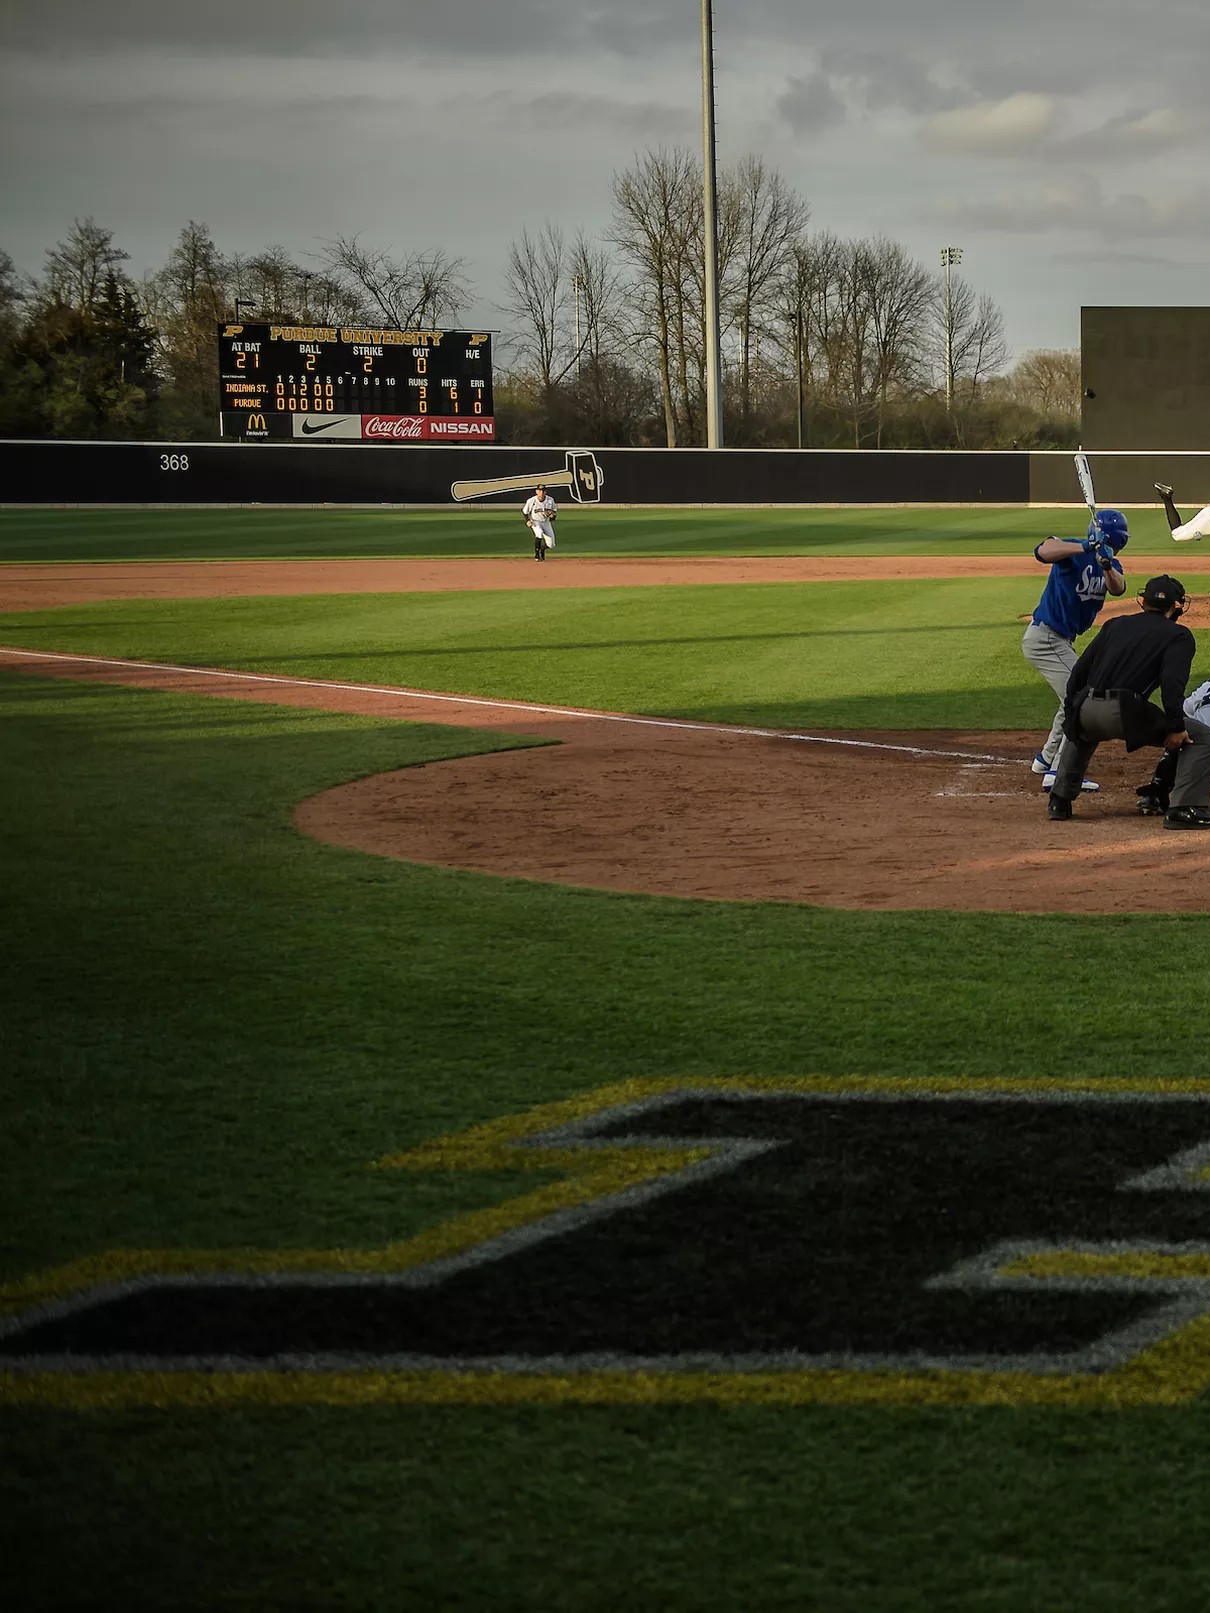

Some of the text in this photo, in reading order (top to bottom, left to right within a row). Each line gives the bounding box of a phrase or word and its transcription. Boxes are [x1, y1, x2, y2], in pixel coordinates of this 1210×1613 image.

[270, 326, 443, 346] PURDUE UNIVERSITY
[231, 342, 261, 352] AT BAT
[299, 344, 321, 354] BALL
[352, 346, 383, 357] STRIKE
[412, 347, 430, 358] OUT
[465, 349, 480, 359] H/E
[306, 354, 316, 371] 2
[363, 355, 373, 372] 2
[417, 357, 427, 374] 0
[277, 375, 396, 386] 1 2 3 4 5 6 7 8 9 10
[408, 378, 428, 387] RUNS
[441, 378, 458, 388] HITS
[470, 379, 485, 388] ERR
[225, 382, 482, 400] INDIANA ST. 0 1 2 0 0 3 6 1
[233, 397, 482, 414] PURDUE 0 0 0 0 0 0 1 0
[365, 416, 425, 438] Coca-Cola
[430, 422, 493, 434] NISSAN
[160, 454, 189, 470] 368
